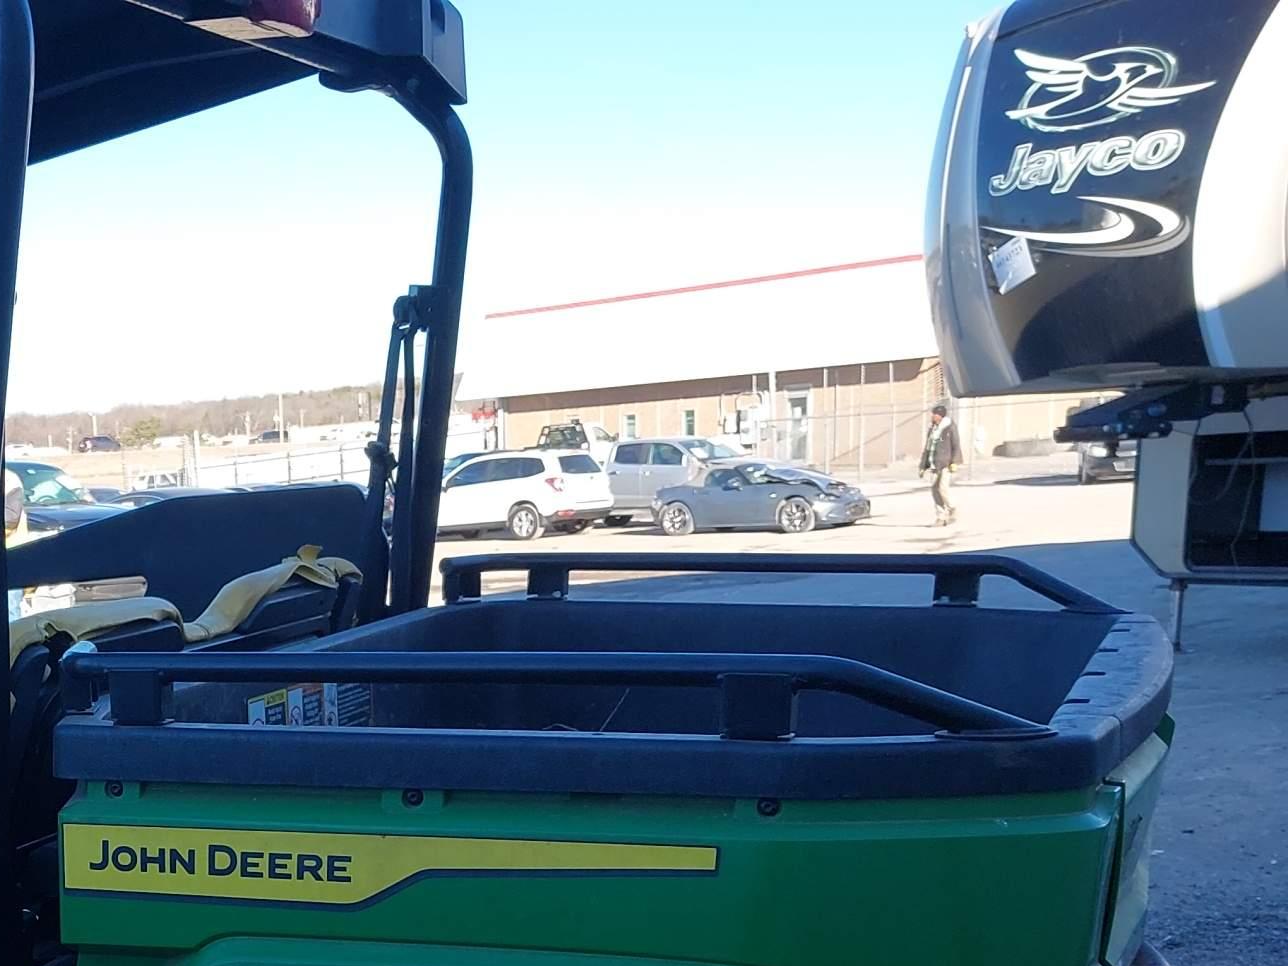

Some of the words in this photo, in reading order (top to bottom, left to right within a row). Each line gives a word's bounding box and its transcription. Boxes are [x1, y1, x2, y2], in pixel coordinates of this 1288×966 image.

[988, 128, 1186, 197] Jayco
[89, 839, 196, 875] JOHN
[207, 844, 352, 883] DEERE
